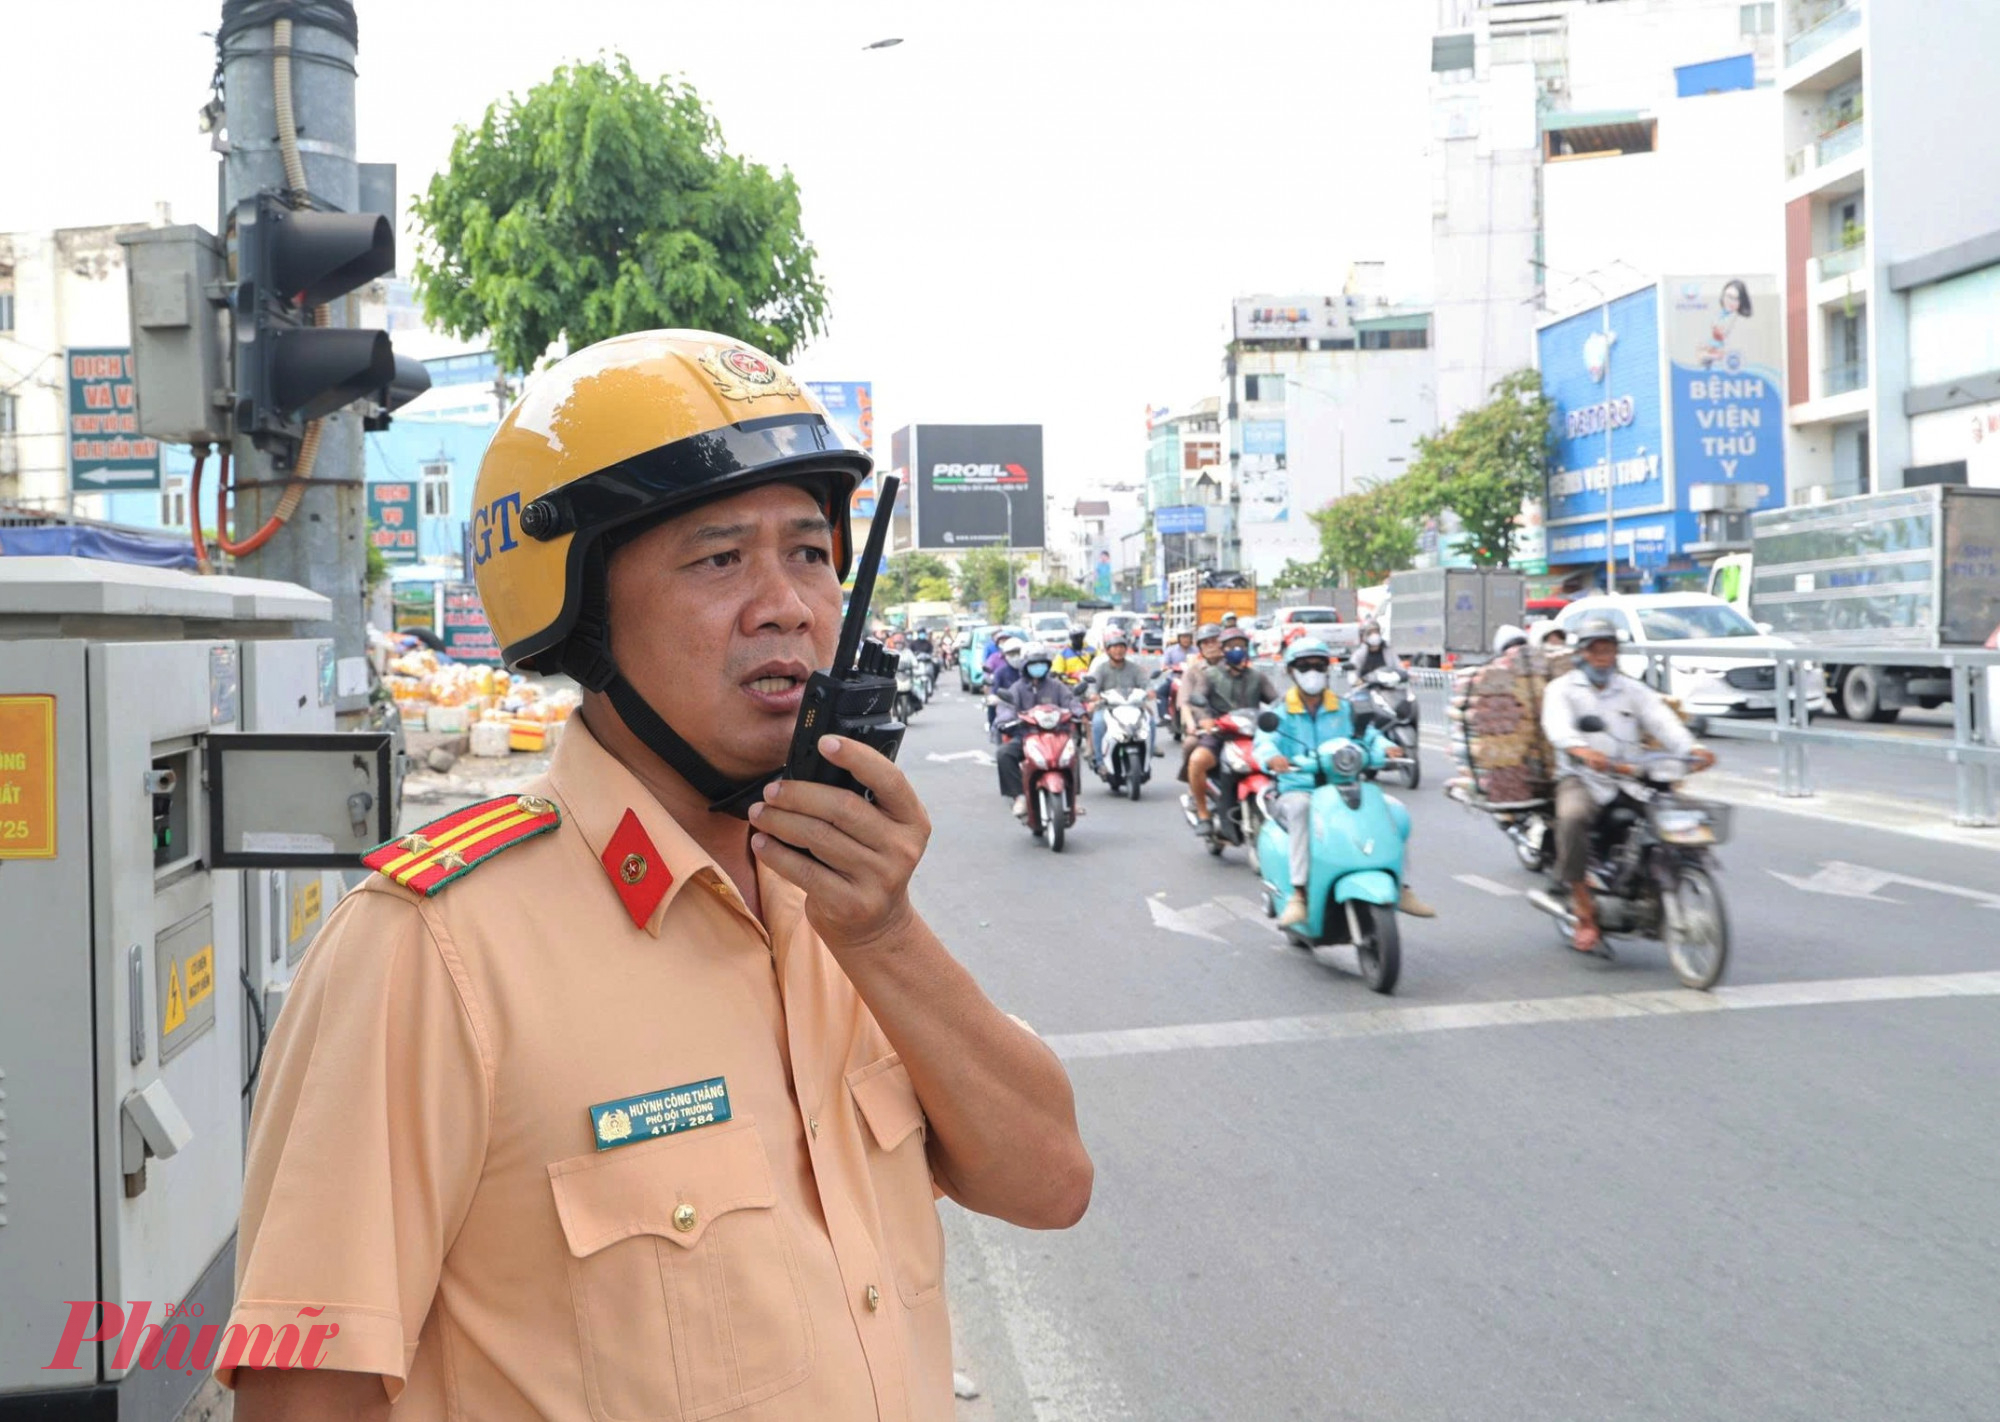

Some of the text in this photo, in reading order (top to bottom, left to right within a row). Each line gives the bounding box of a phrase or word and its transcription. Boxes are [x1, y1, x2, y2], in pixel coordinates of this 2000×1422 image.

[72, 354, 122, 383] DỊCH
[1689, 375, 1764, 405] BỆNH
[1696, 404, 1761, 433] VIỆN
[1702, 432, 1756, 457] THÚ
[932, 463, 1009, 478] PROEL
[1720, 458, 1738, 479] Y
[473, 491, 521, 566] GT
[629, 1100, 664, 1117] HUỲNH
[664, 1092, 692, 1109] CÔNG
[645, 1111, 663, 1126] PHÓ
[651, 1121, 676, 1135] 417
[689, 1113, 714, 1127] 284
